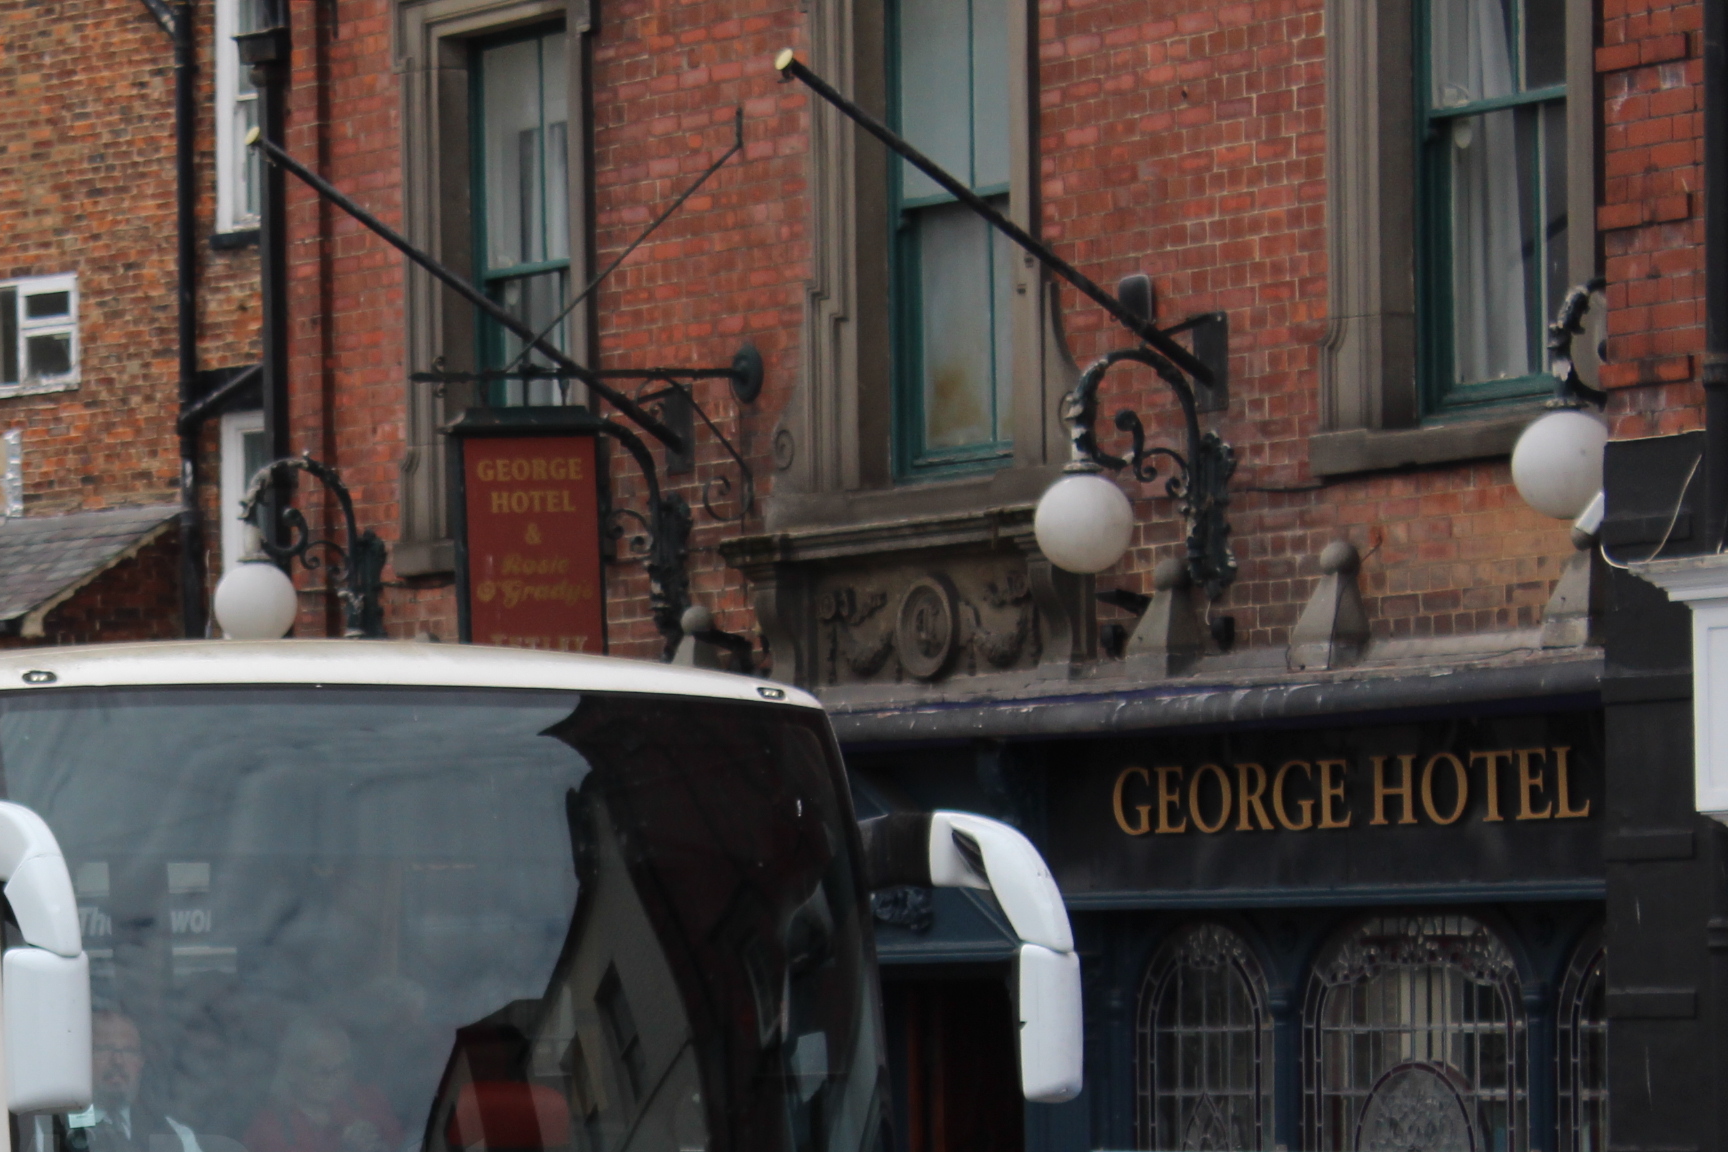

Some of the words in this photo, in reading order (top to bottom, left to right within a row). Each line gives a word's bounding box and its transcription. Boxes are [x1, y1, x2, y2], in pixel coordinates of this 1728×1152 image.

[476, 457, 584, 482] GEORGE
[490, 490, 577, 514] HOTEL
[524, 522, 542, 545] &
[1112, 759, 1352, 836] GEORGE
[1369, 746, 1590, 826] HOTEL
